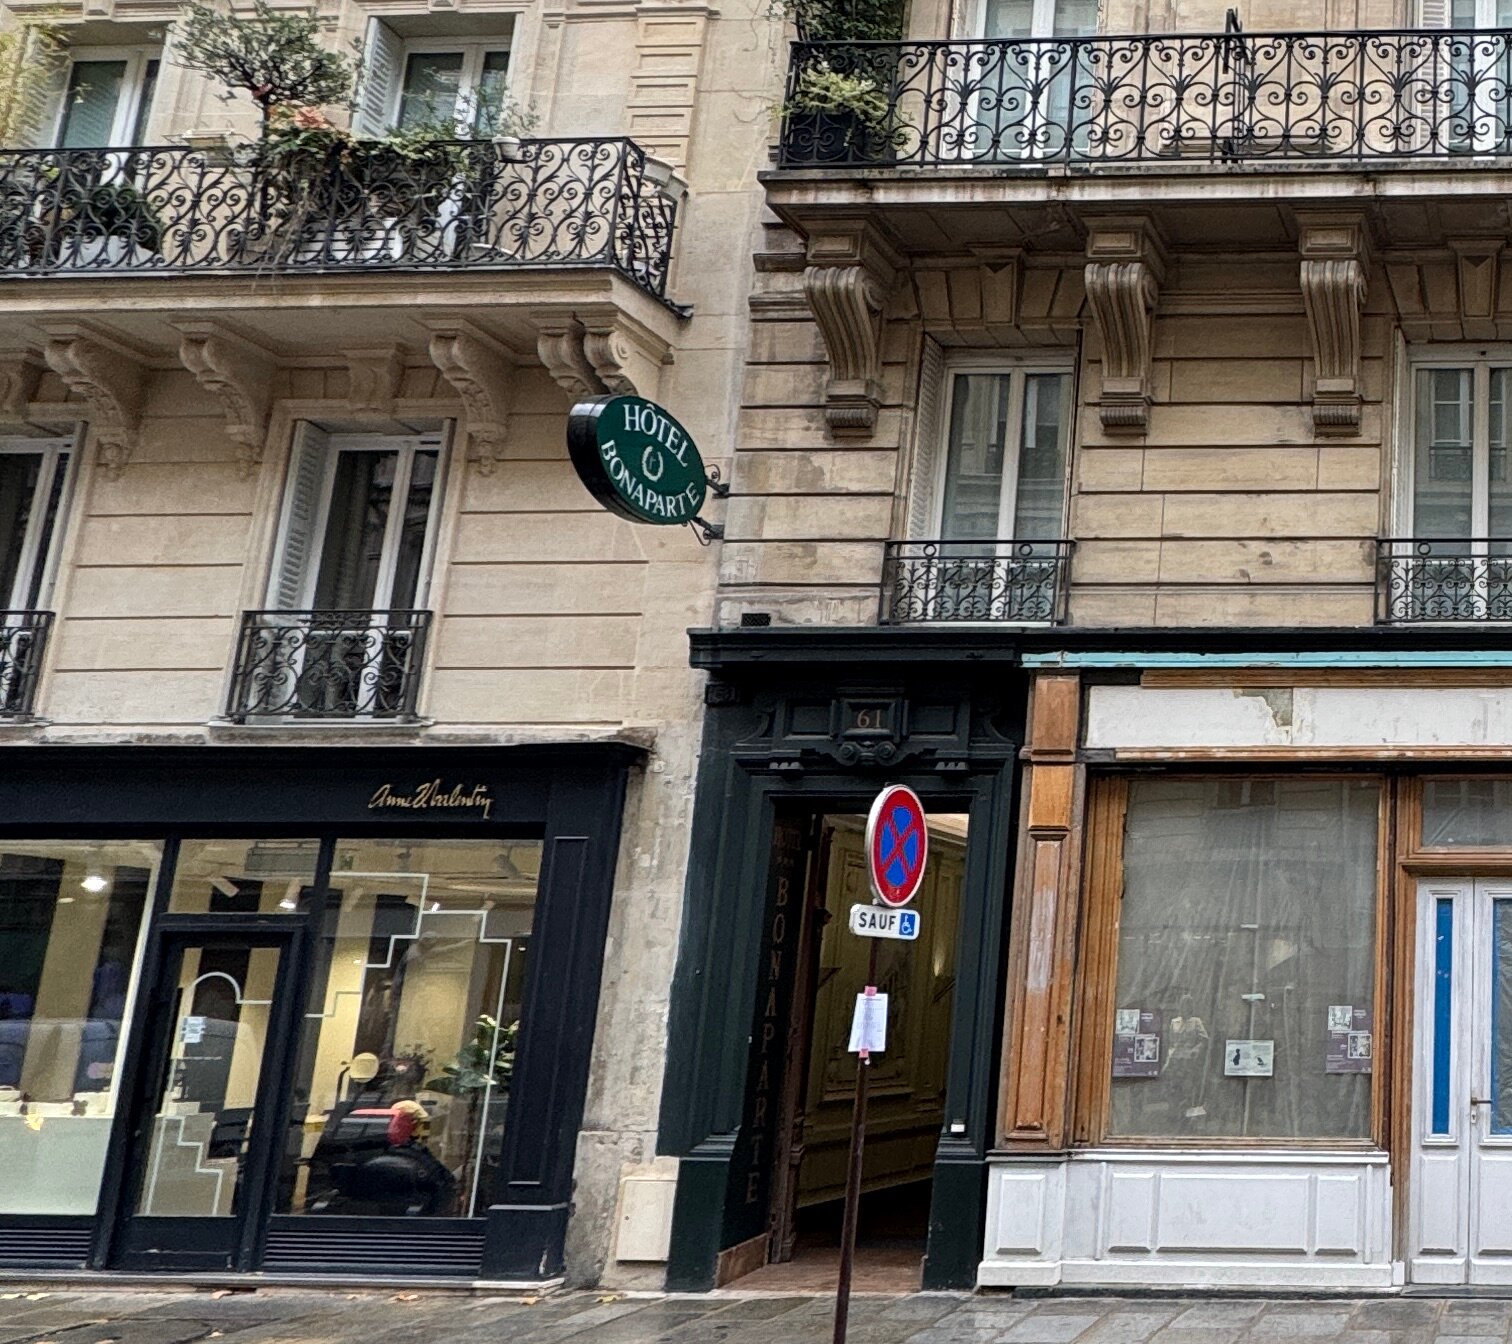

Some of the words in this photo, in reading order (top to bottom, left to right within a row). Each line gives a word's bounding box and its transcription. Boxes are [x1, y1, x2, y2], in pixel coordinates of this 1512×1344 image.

[623, 403, 688, 467] HÔTEL
[601, 439, 700, 517] BONAPARTE
[857, 708, 881, 728] 61
[858, 912, 897, 930] SAUF
[744, 876, 790, 1205] BONAPARTE
